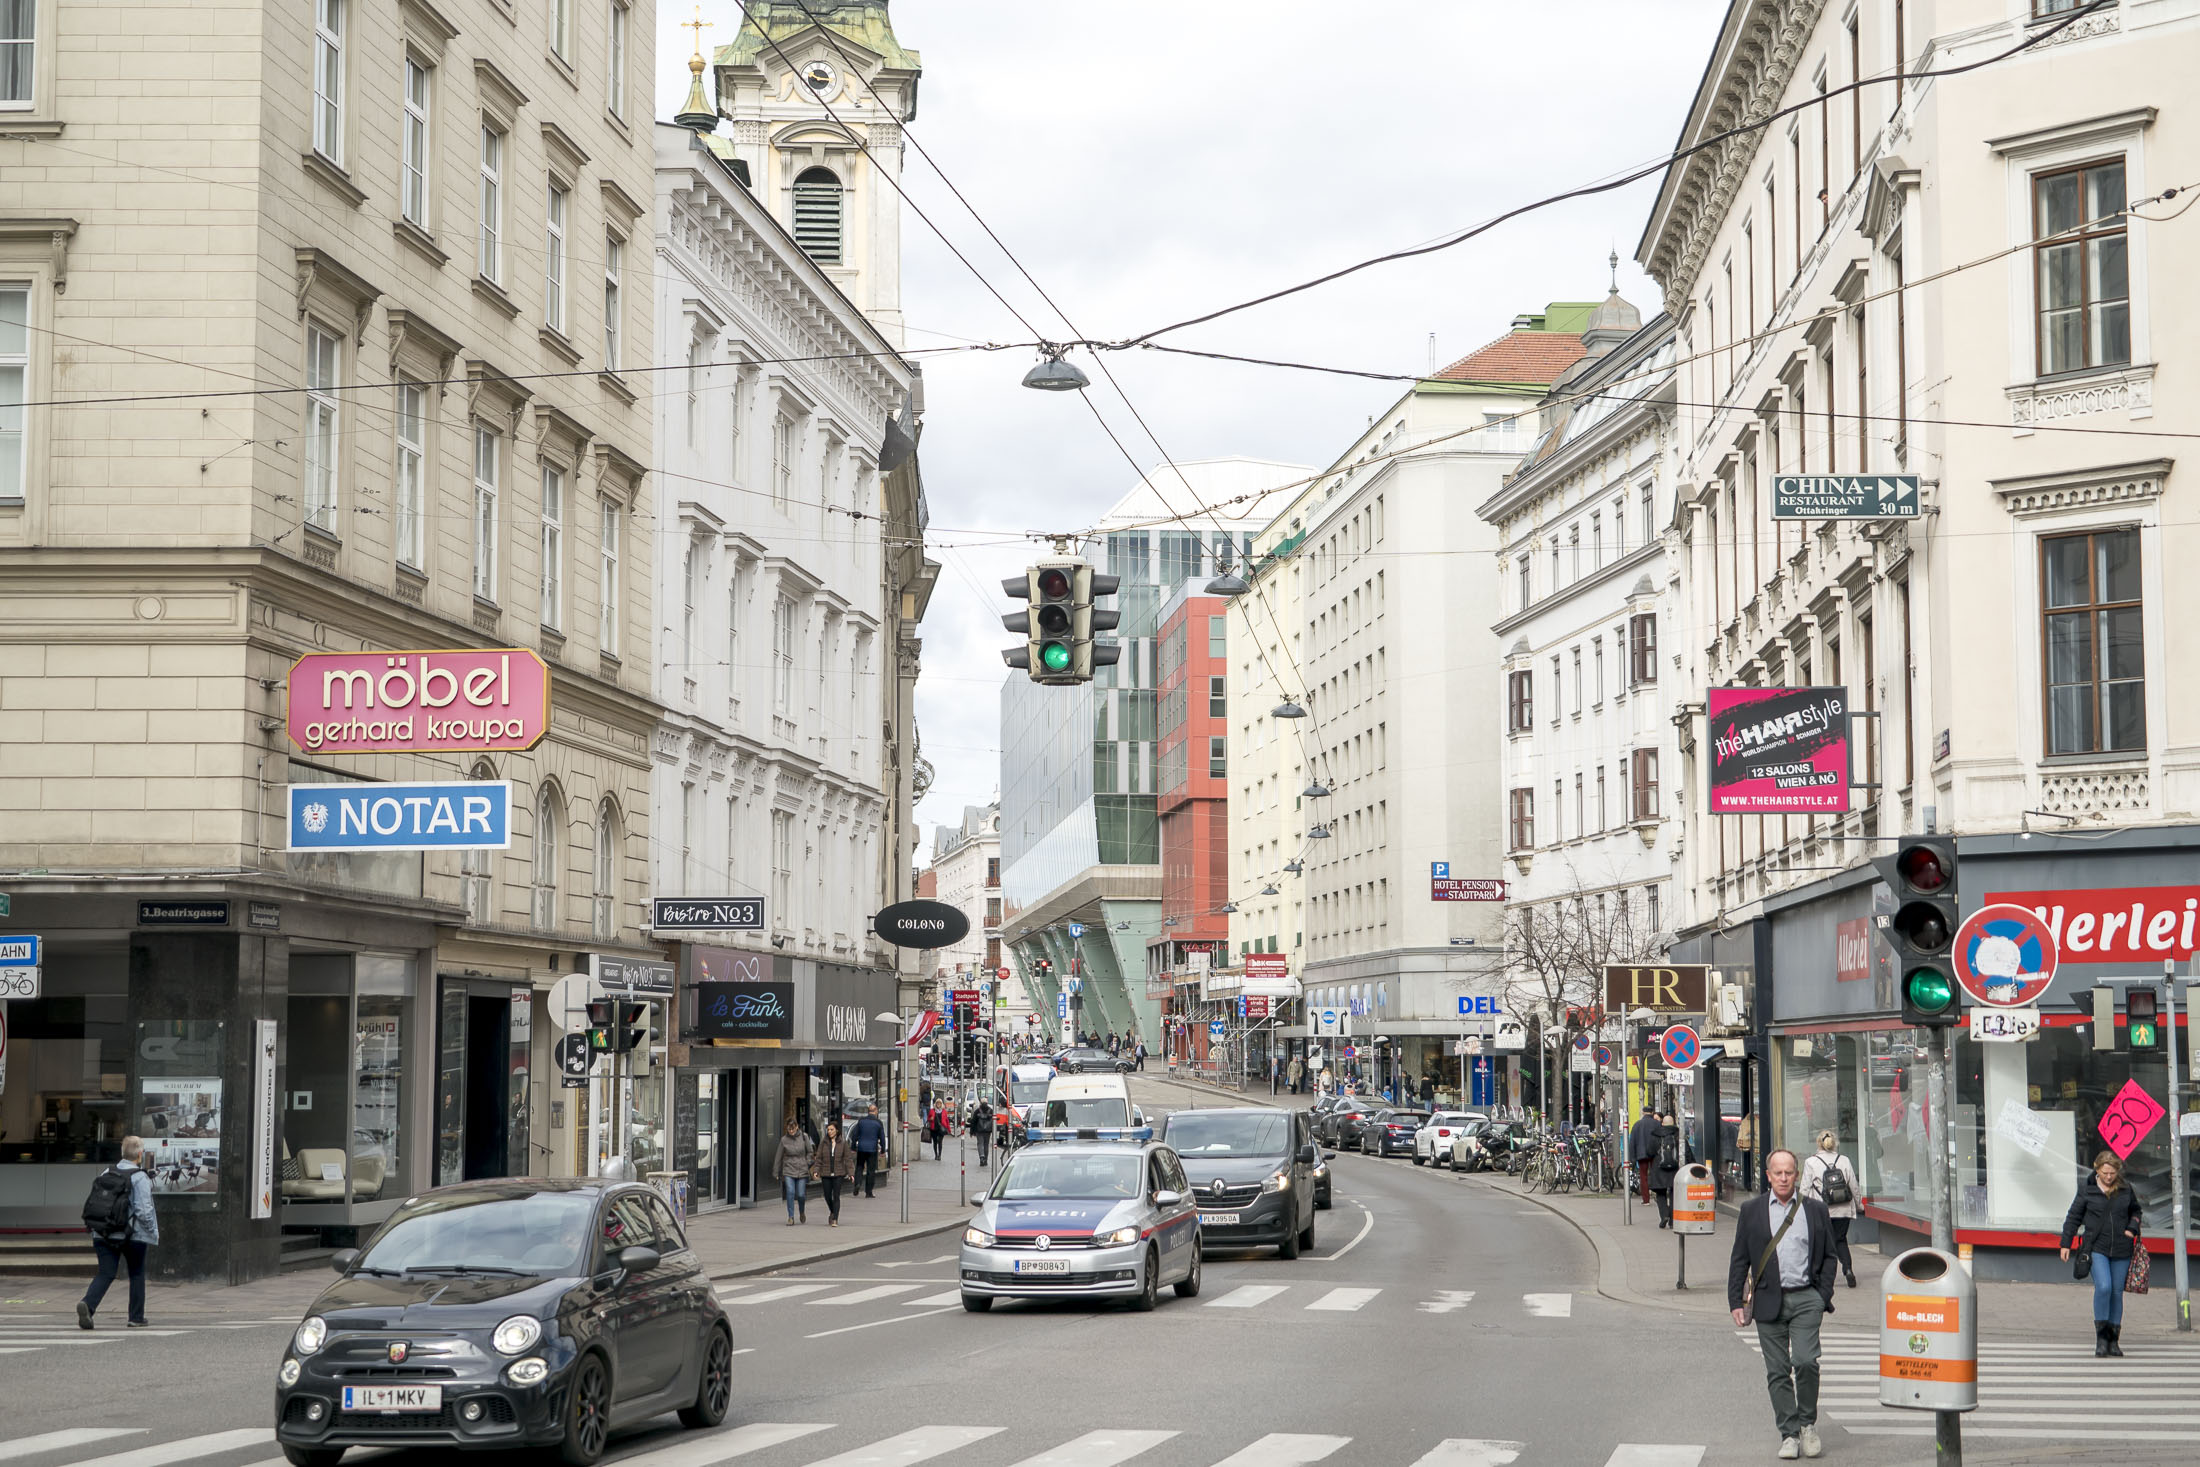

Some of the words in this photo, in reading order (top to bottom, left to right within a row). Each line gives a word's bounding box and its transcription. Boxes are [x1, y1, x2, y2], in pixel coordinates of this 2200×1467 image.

[1778, 477, 1873, 495] CHINA-
[1779, 496, 1865, 506] RESTAURANT
[1879, 503, 1896, 515] 30
[1899, 504, 1914, 515] m
[322, 655, 511, 709] möbel
[304, 715, 414, 748] gerhard
[427, 715, 524, 744] kroupa
[1741, 738, 1787, 758] WORLDCHAMPION
[1751, 768, 1763, 778] 12
[1765, 763, 1811, 777] SALONS
[1777, 777, 1806, 788] WIEN
[1808, 776, 1818, 786] &
[1819, 772, 1836, 785] NÖ
[1720, 796, 1839, 806] WWW.THEHAIRSTYLE.AT
[339, 796, 493, 835] NOTAR
[1436, 864, 1445, 875] P
[1434, 880, 1460, 890] HOTEL
[1461, 880, 1495, 890] PENSION
[1448, 890, 1496, 900] STADTPARK
[663, 905, 713, 923] Bistro
[897, 918, 945, 930] COLONO
[1838, 928, 1868, 973] Allerlei
[1628, 968, 1686, 1006] HR
[955, 993, 978, 1001] Stadtpark
[1458, 996, 1502, 1014] DEL
[826, 1003, 866, 1042] COLONO
[1015, 1209, 1087, 1219] POLIZEI
[1021, 1262, 1032, 1271] BP
[1038, 1262, 1065, 1271] 90843
[387, 1390, 426, 1406] 1MKV
